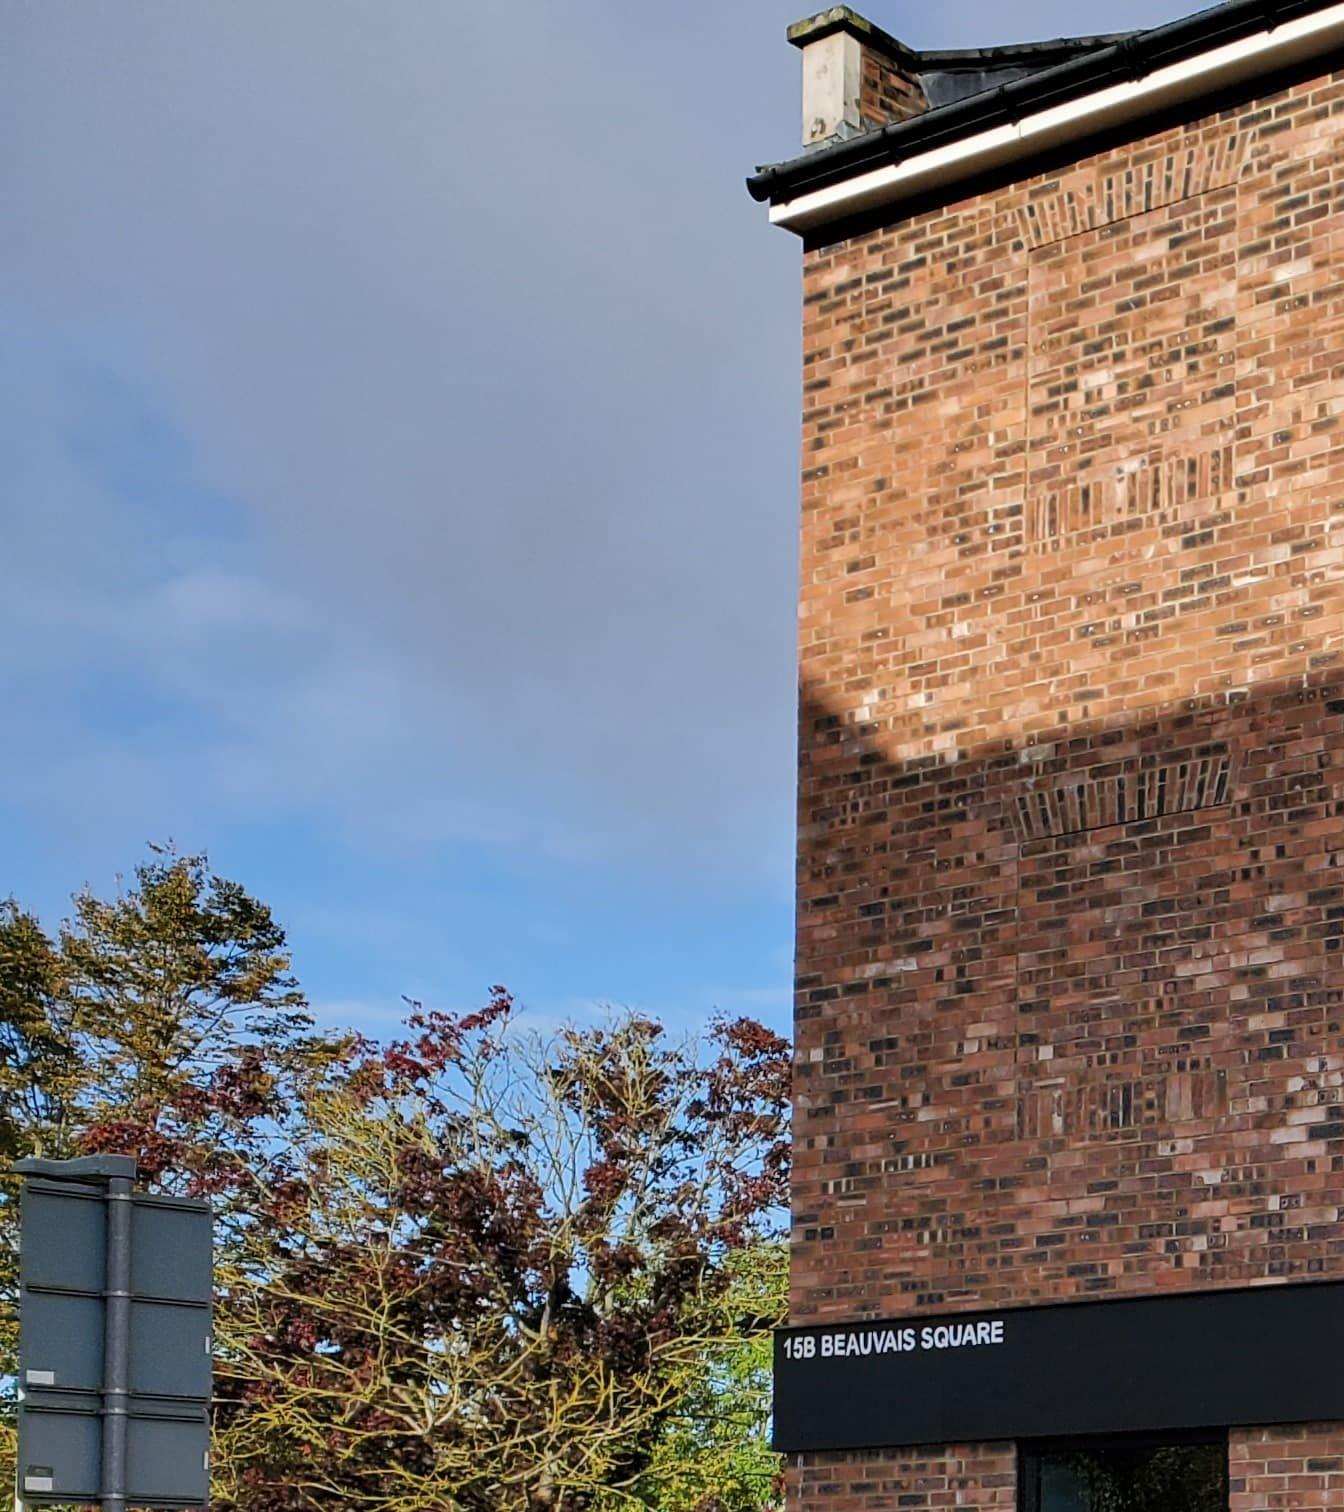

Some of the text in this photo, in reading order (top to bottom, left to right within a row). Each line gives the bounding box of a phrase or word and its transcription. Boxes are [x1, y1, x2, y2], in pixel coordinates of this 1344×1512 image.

[783, 1321, 1005, 1359] 15B BEAUVAIS SQUARE
